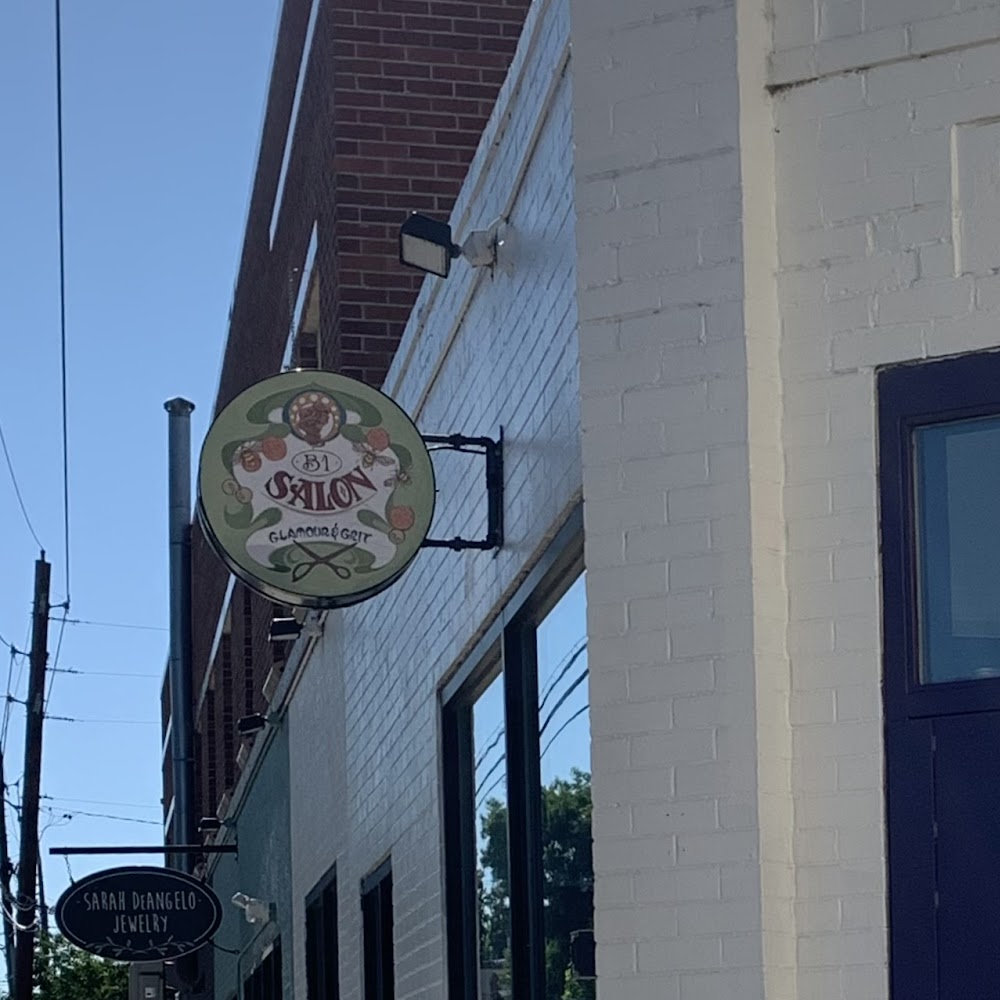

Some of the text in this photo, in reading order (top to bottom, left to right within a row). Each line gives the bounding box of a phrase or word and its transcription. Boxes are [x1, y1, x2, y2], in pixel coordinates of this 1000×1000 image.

[302, 454, 330, 472] B1
[264, 465, 378, 511] SALON
[269, 526, 330, 543] GLAMOUR
[341, 528, 372, 543] GRIT
[83, 891, 126, 911] SARAH
[113, 914, 168, 933] JEWELRY
